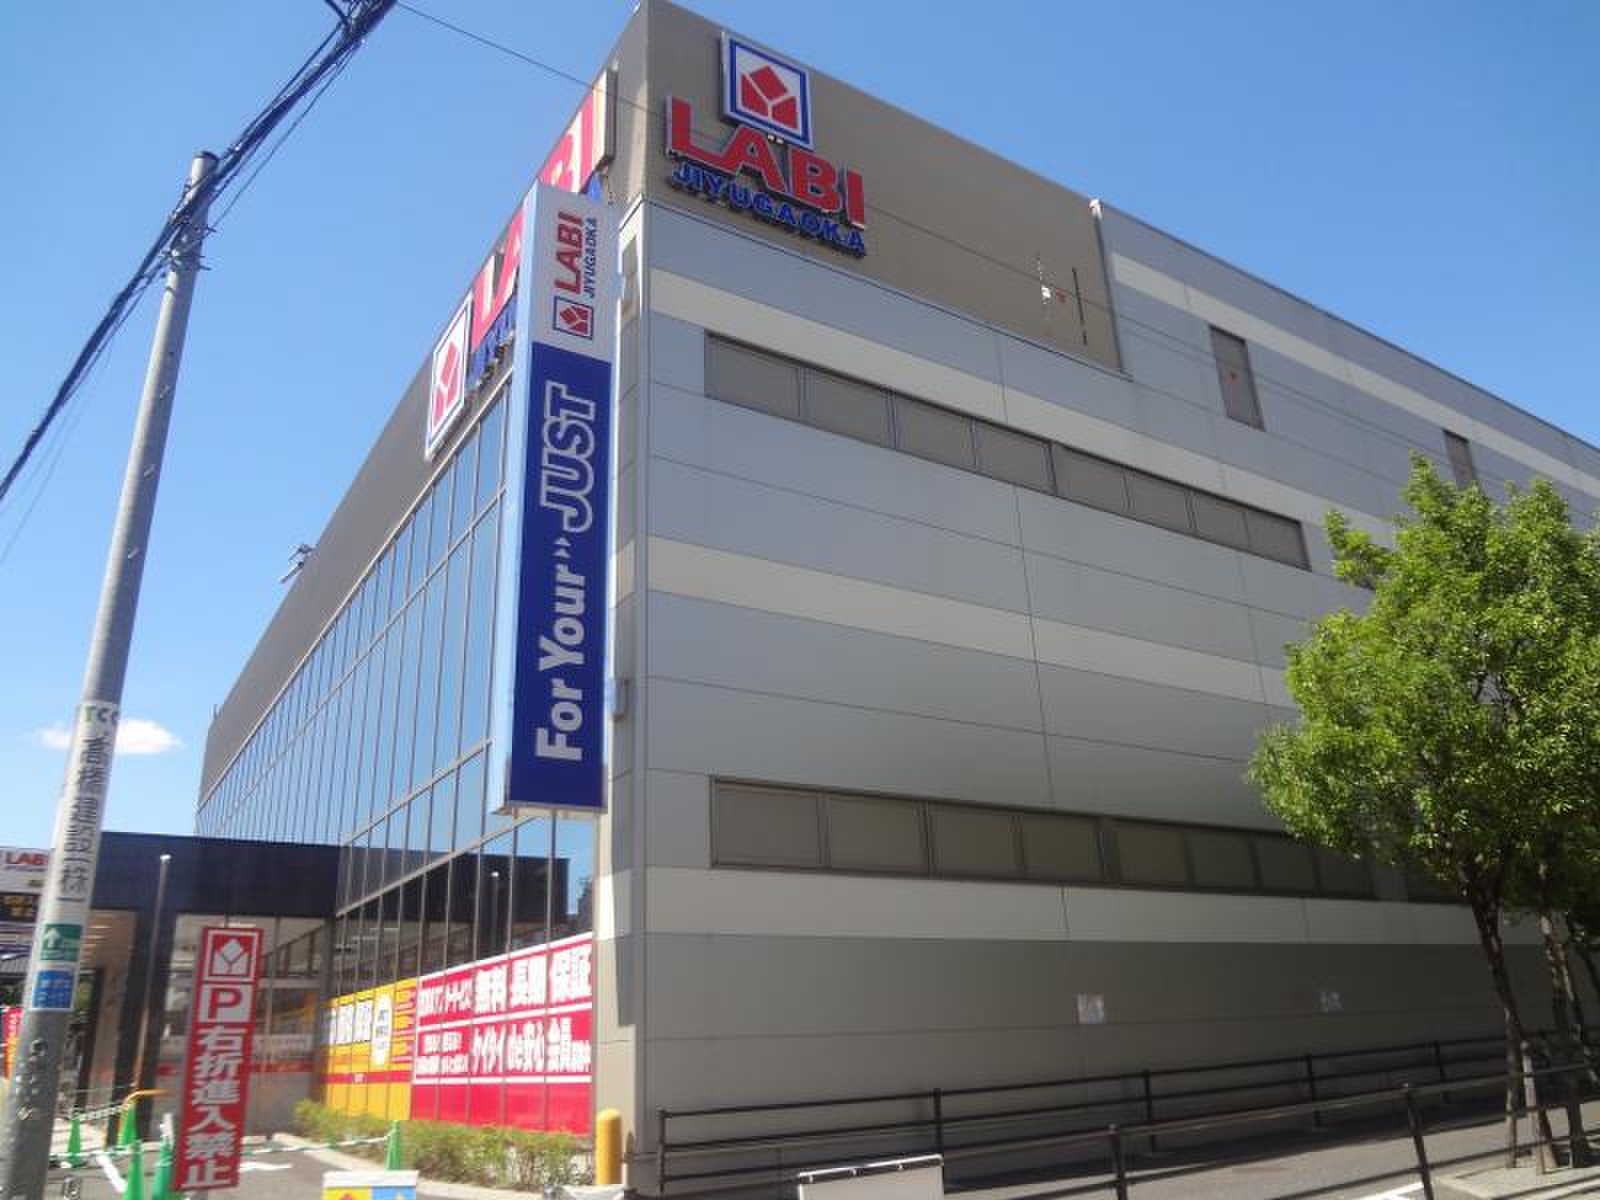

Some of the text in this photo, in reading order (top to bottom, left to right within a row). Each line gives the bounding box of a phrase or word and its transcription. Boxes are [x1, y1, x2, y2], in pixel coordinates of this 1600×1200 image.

[666, 95, 866, 230] LABI
[671, 160, 867, 255] JIYUGAOKA
[554, 210, 584, 295] LABI
[583, 216, 598, 299] JIYUGAOKA
[536, 380, 598, 762] For Your JUST
[5, 851, 50, 866] LAB
[207, 986, 244, 1023] P
[181, 1025, 247, 1190] 右折進入禁止
